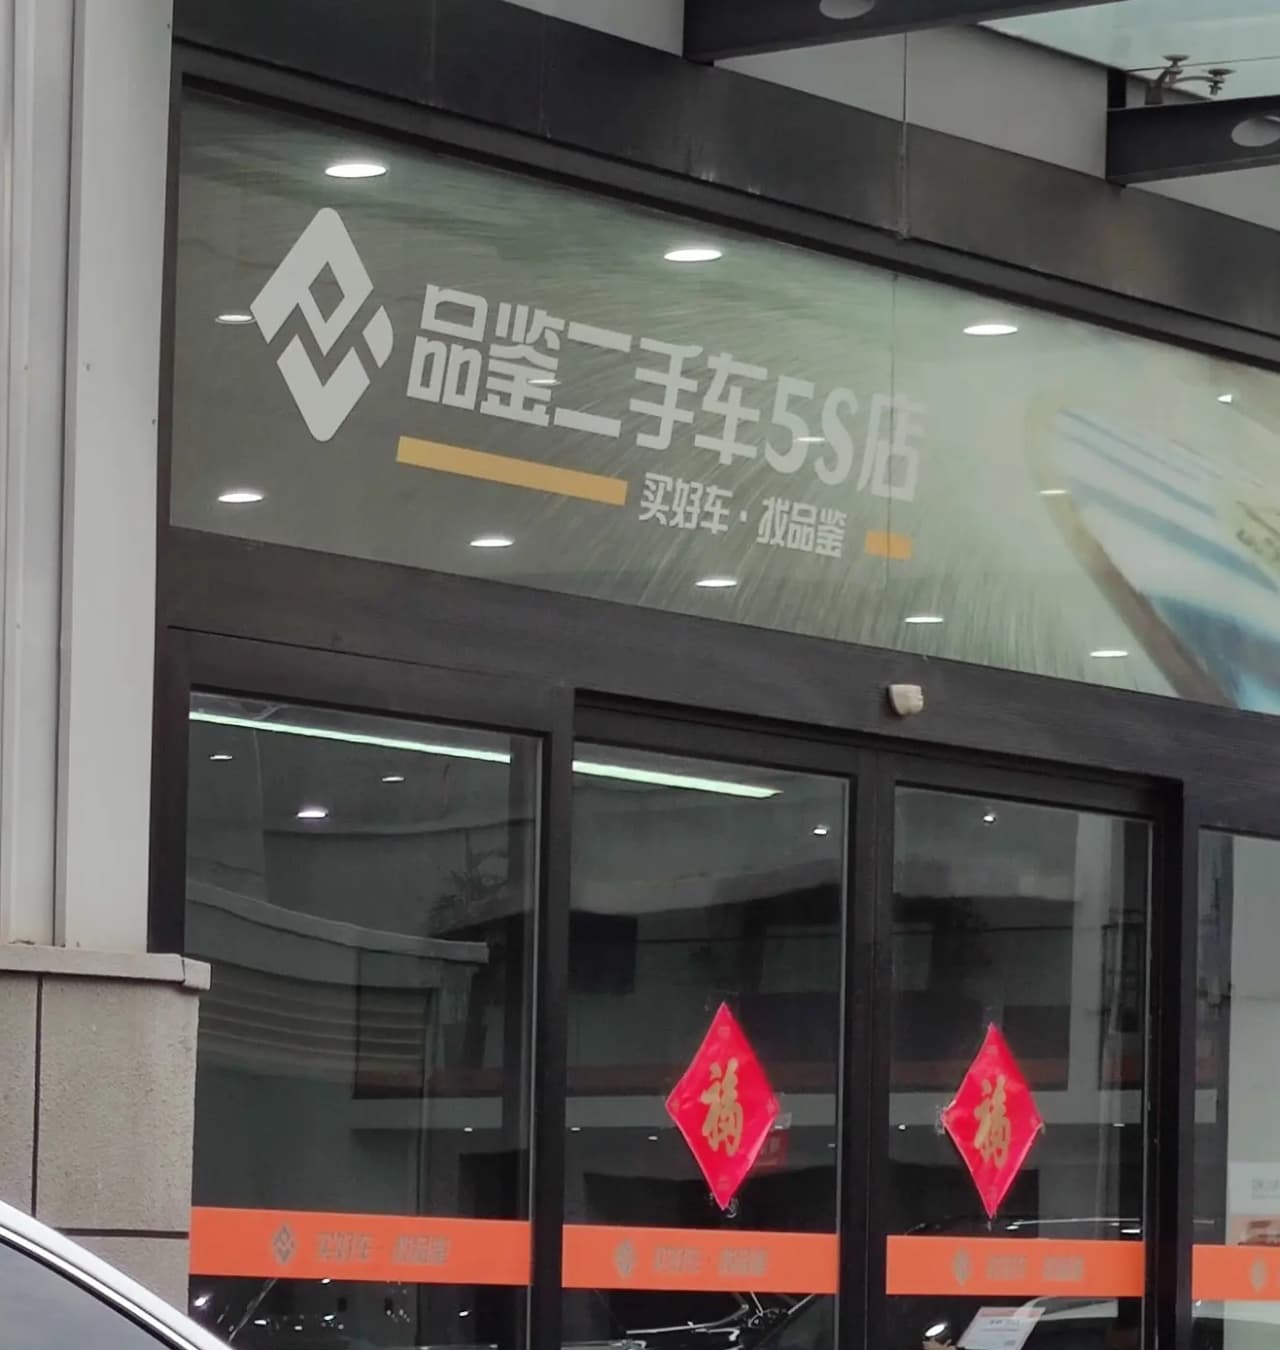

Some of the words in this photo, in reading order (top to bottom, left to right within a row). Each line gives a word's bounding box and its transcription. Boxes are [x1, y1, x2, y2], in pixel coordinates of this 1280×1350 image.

[406, 283, 929, 503] 品鉴二手车5S店
[701, 1057, 744, 1156] 福
[973, 1073, 1012, 1171] 福
